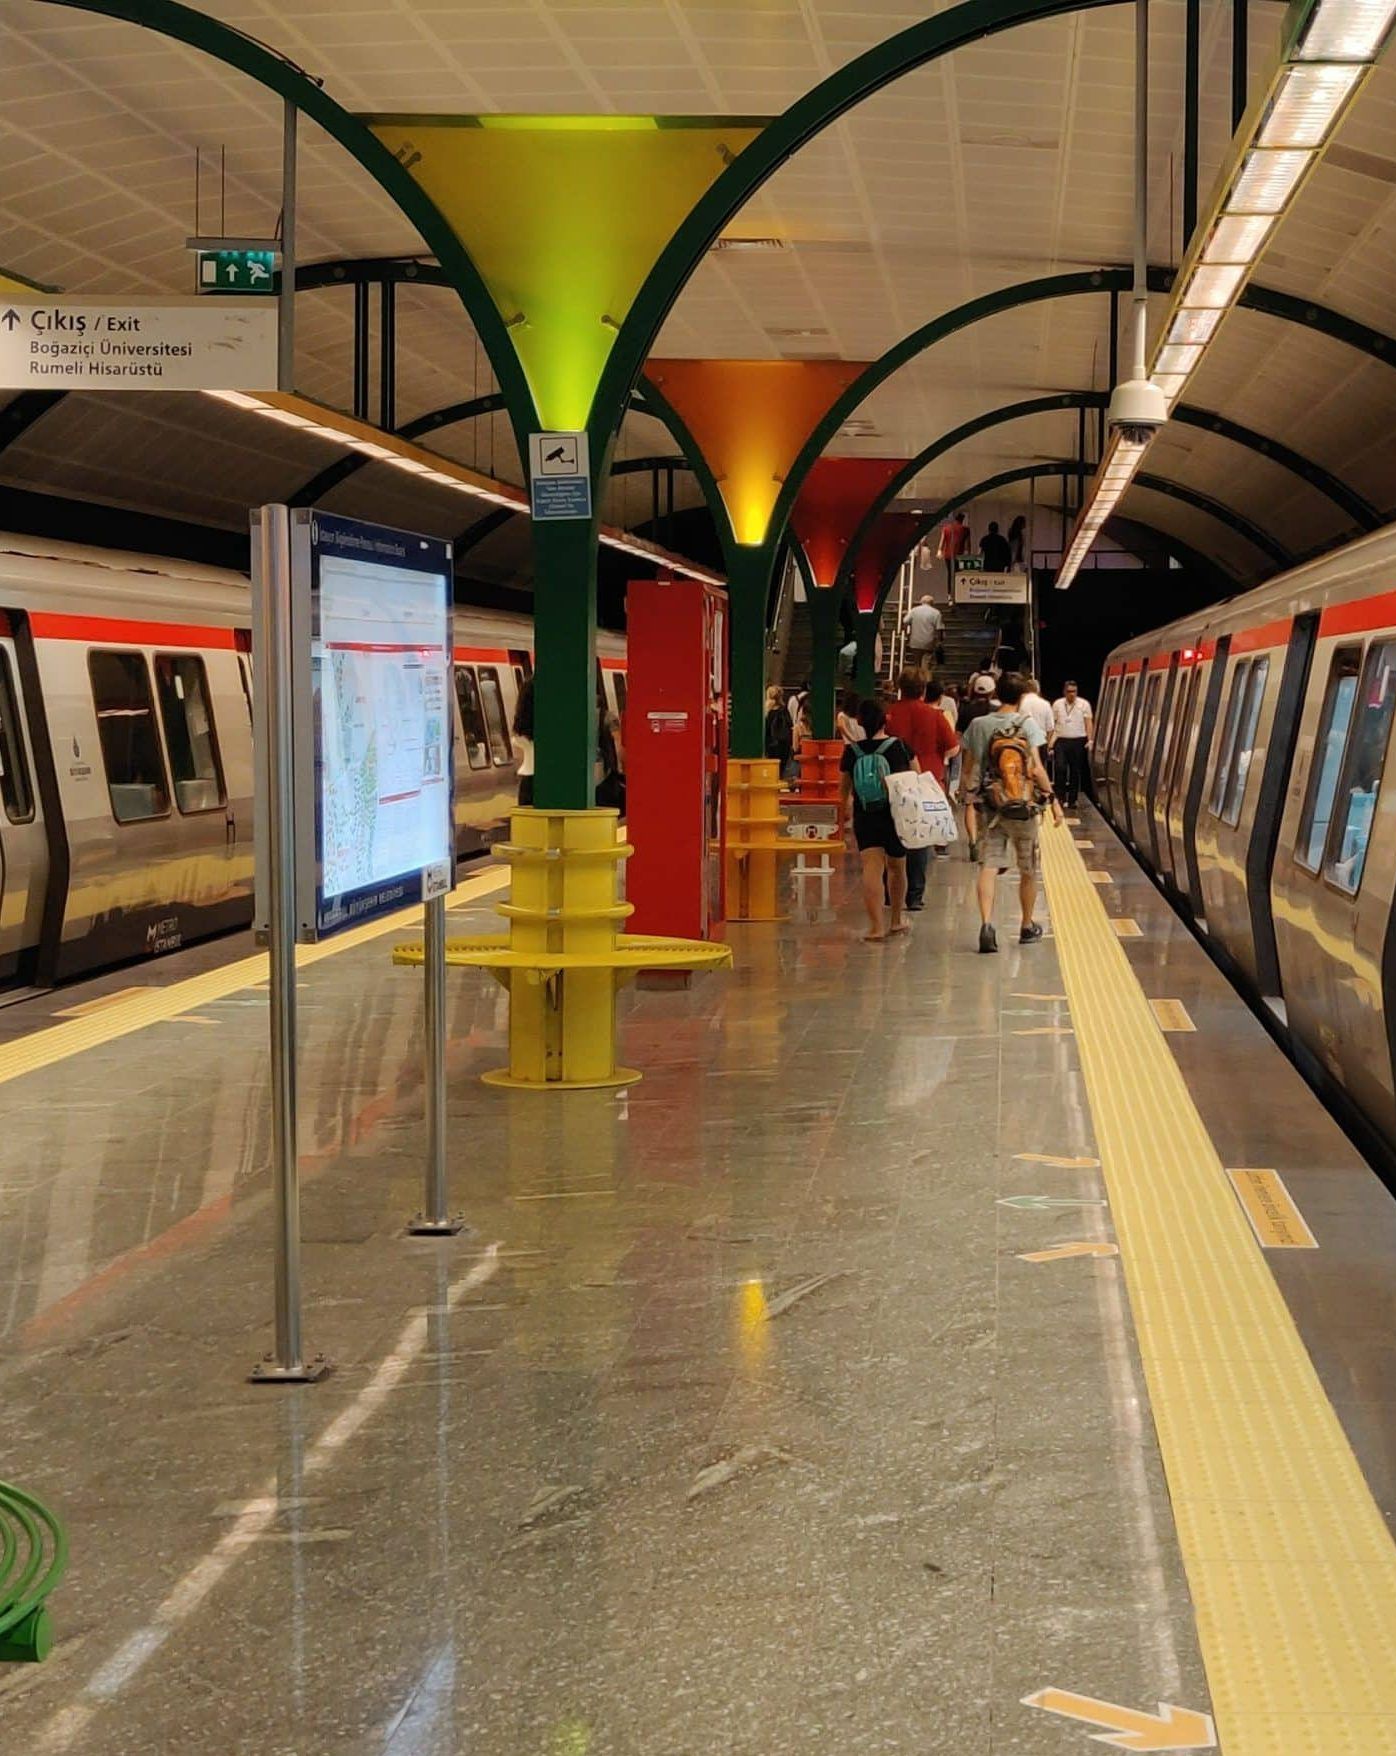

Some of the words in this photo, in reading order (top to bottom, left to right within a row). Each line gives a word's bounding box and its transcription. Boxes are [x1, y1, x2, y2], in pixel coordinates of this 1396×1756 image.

[30, 308, 86, 336] Çıkış
[94, 317, 101, 331] /
[107, 315, 140, 332] Exit
[30, 340, 95, 358] Boğaziçi
[100, 338, 193, 357] Üniversitesi
[29, 361, 83, 375] Rumeli
[88, 361, 163, 376] Hisarüstü
